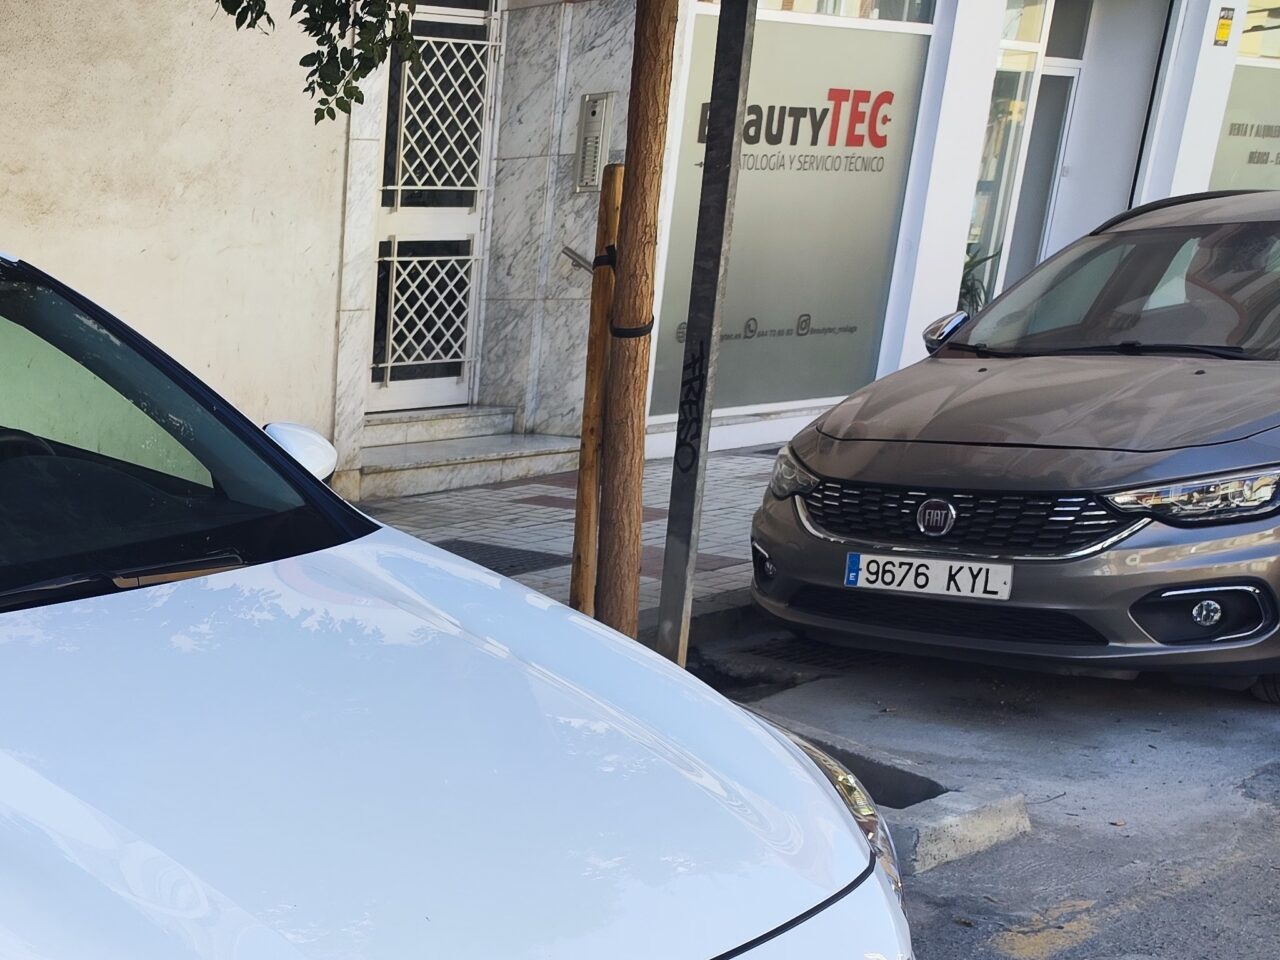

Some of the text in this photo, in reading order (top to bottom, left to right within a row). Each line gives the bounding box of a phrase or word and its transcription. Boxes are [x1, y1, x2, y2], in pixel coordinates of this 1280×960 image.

[788, 154, 797, 171] Y
[796, 154, 842, 172] SERVICIO
[843, 153, 885, 173] TÉCNICO
[924, 509, 947, 527] FIAT
[849, 572, 857, 581] E
[865, 559, 998, 596] 9676 KYL
